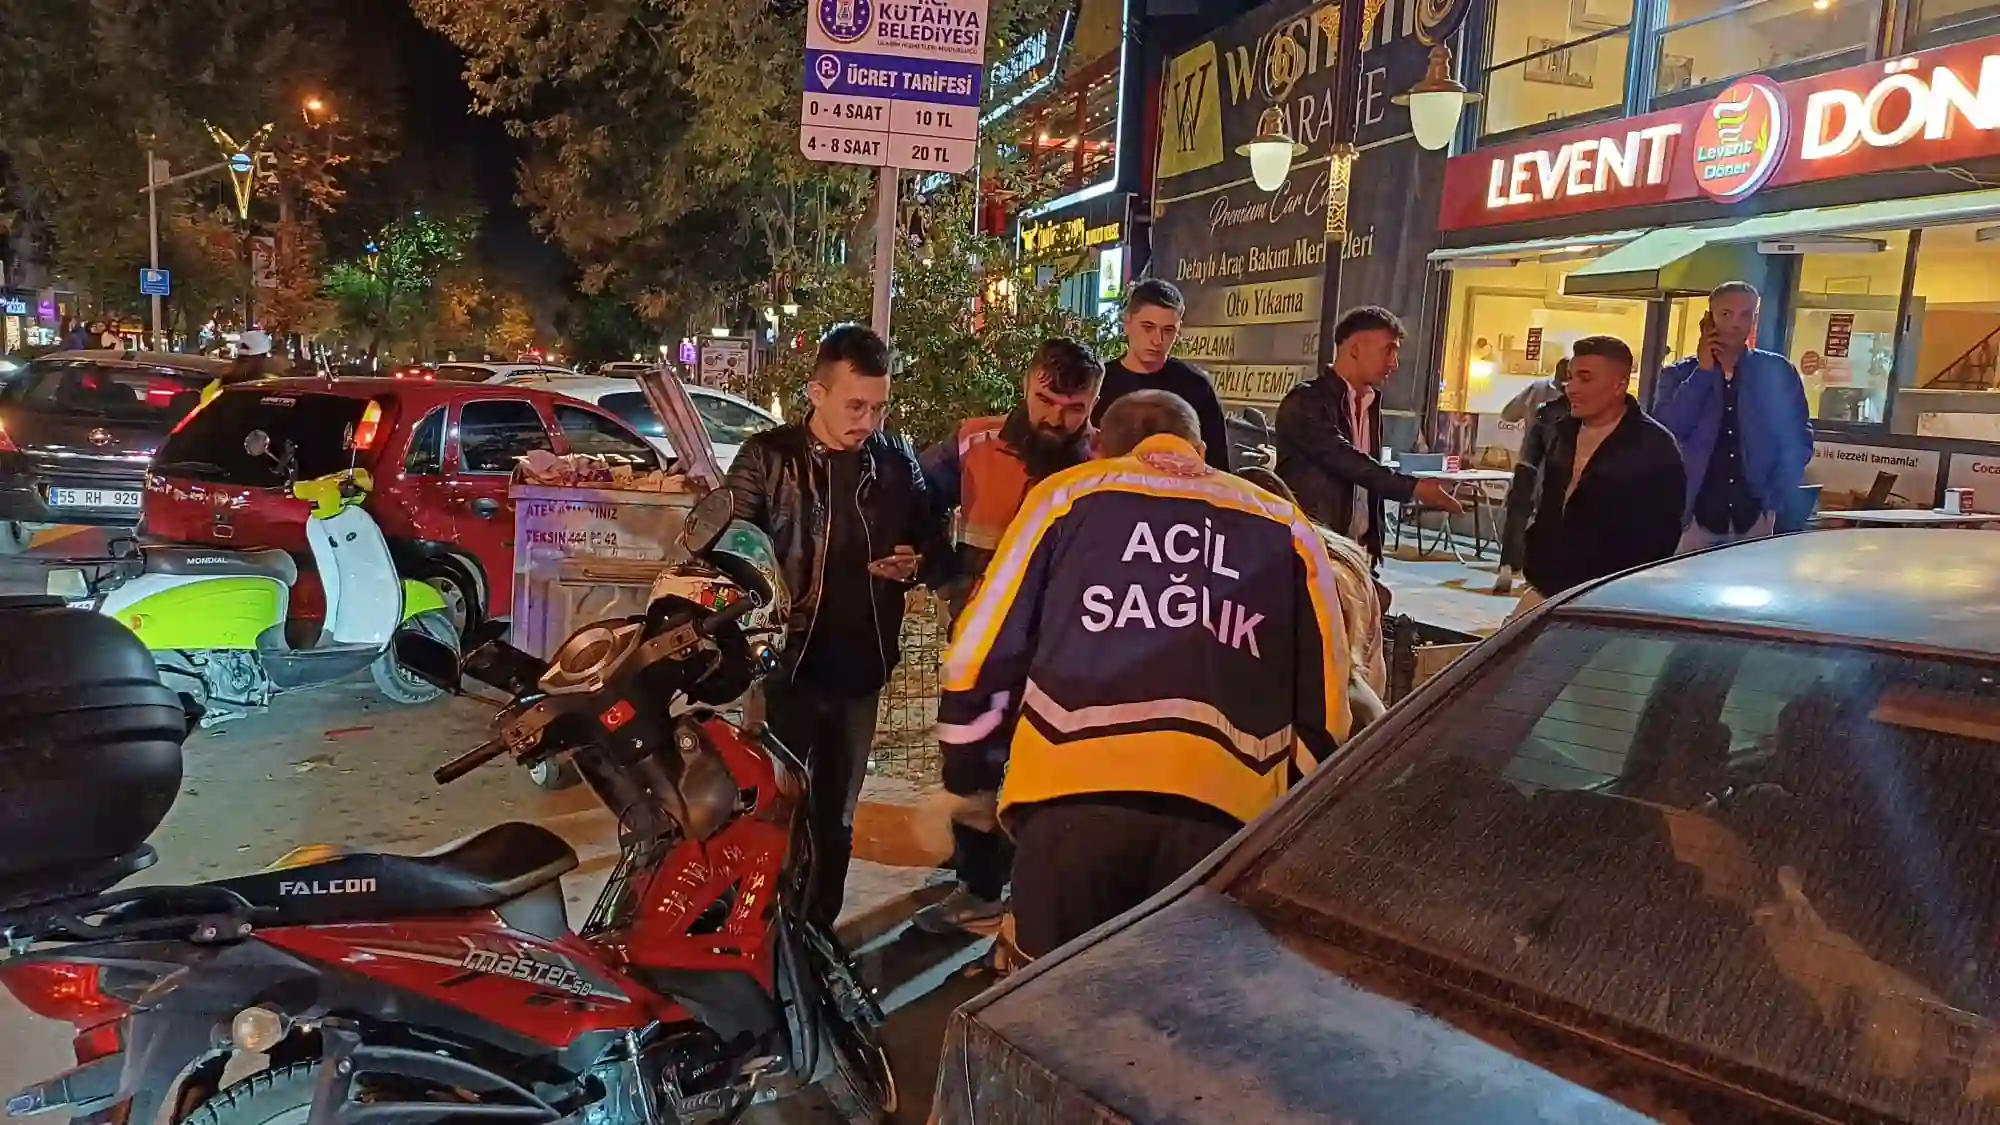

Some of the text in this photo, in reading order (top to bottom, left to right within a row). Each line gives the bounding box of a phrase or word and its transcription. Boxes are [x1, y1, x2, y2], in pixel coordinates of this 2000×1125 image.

[879, 3, 980, 28] KÜTAHYA
[847, 64, 973, 96] ÜCRET TARİFESİ
[810, 101, 818, 116] 0
[833, 103, 841, 117] 4
[846, 104, 883, 121] SAAT
[916, 110, 953, 128] 10 TL
[808, 136, 816, 151] 4
[831, 138, 840, 153] 8
[844, 139, 881, 156] SAAT
[912, 145, 950, 163] 20 TL
[1696, 140, 1753, 162] Levent
[1487, 122, 1682, 209] LEVENT
[1209, 195, 1267, 236] Premium
[1269, 180, 1304, 223] Car
[1176, 250, 1216, 285] Detaylı
[1218, 250, 1245, 280] Araç
[1248, 244, 1290, 272] Bakım
[1226, 288, 1304, 317] Oto Yıkama
[1871, 454, 1919, 469] tamamla!
[59, 490, 138, 506] 55 RH 929
[1121, 516, 1240, 580] ACİL
[186, 556, 228, 565] MONDIAL
[1080, 572, 1265, 660] SAĞLIK
[279, 877, 377, 896] FALCON
